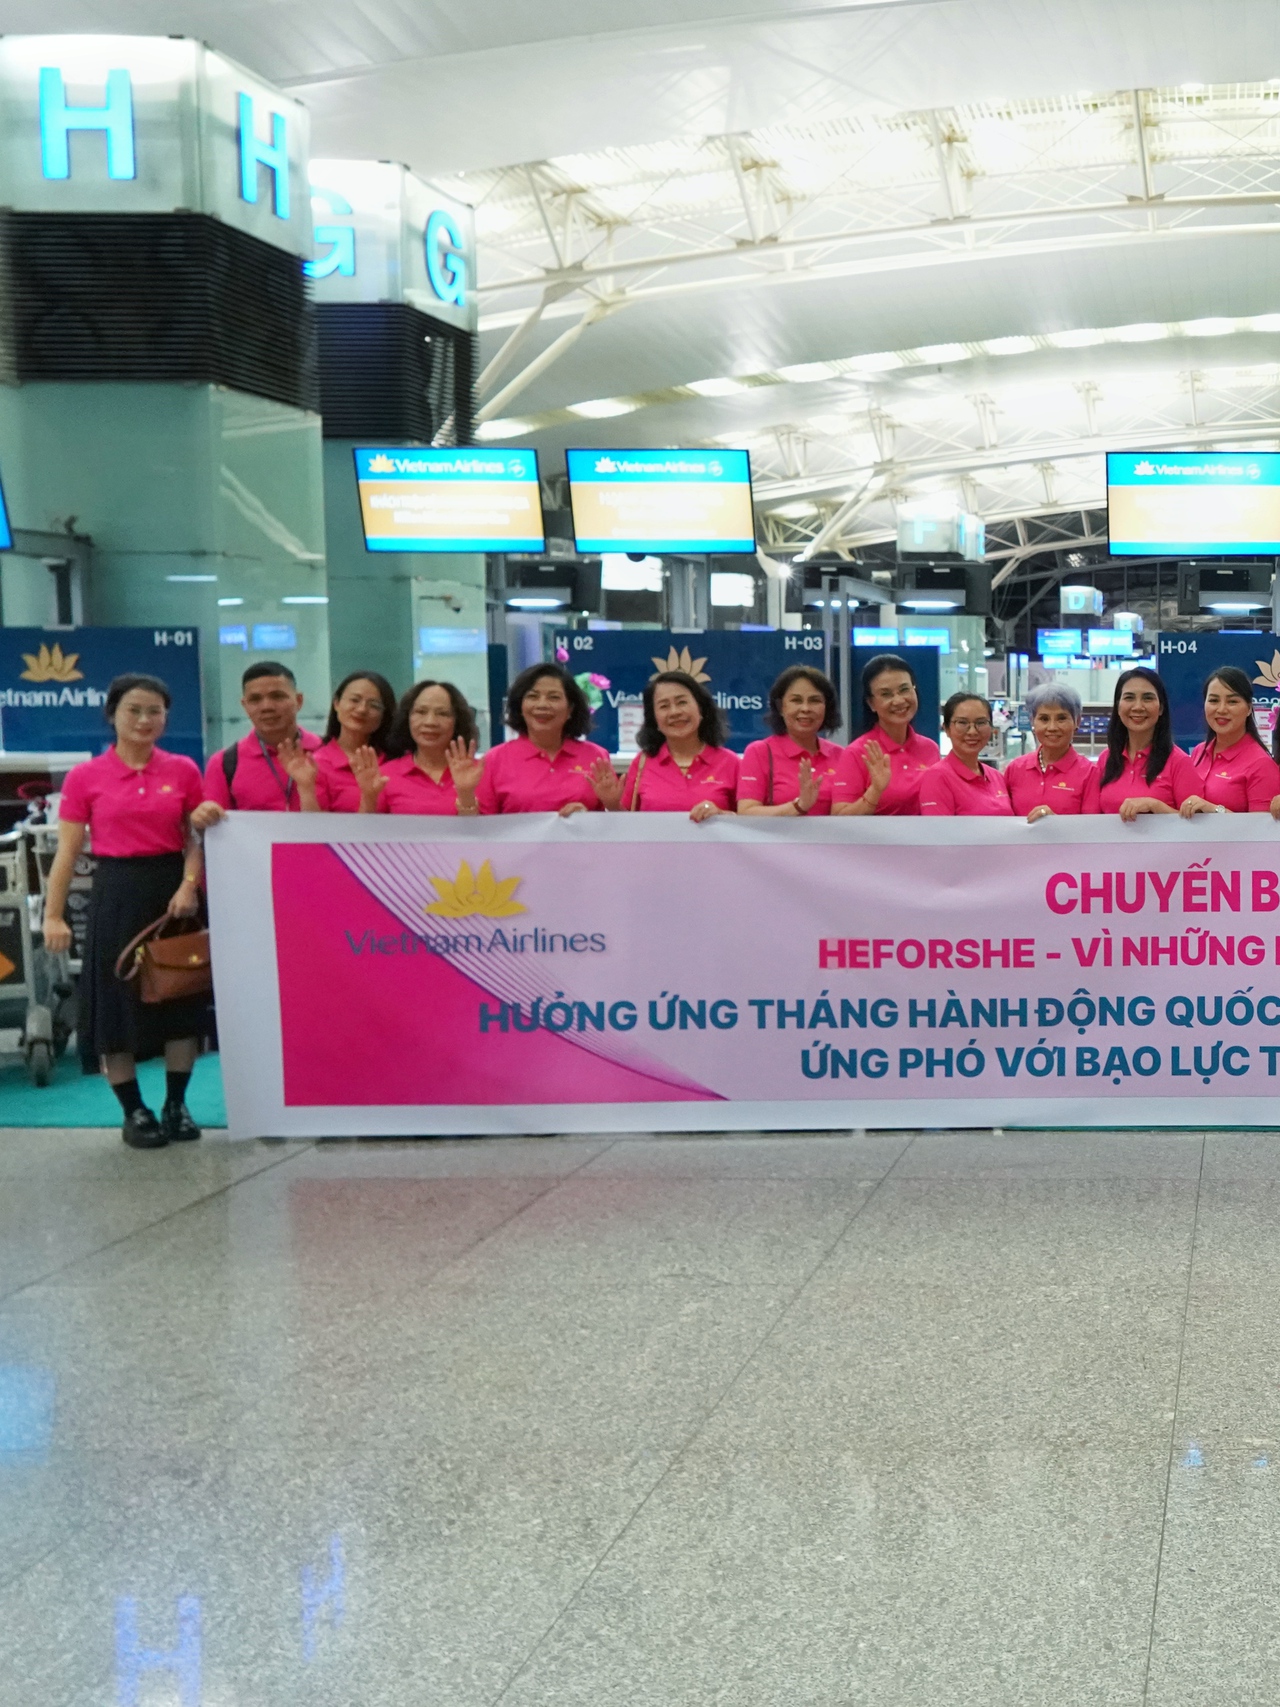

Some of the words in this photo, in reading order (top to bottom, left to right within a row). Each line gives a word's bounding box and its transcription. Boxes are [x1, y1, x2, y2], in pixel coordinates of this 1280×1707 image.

[39, 67, 136, 179] H
[239, 92, 290, 219] H
[425, 210, 465, 306] G
[1068, 592, 1086, 610] D
[154, 630, 193, 647] H-01
[784, 636, 824, 651] H-03
[1160, 640, 1198, 655] H-04
[0, 688, 58, 707] etnam
[59, 686, 107, 707] Airlin
[712, 691, 762, 710] lines
[1045, 858, 1241, 915] CHUYẾN
[343, 929, 481, 955] Vietnam
[487, 927, 607, 954] Airlines
[818, 938, 1036, 970] HEFORSHE
[1072, 928, 1113, 968] VÌ
[1123, 927, 1267, 968] NHỮNG
[478, 991, 638, 1034] HƯỞNG
[648, 991, 739, 1032] ỨNG
[748, 990, 899, 1031] THÁNG
[909, 989, 1029, 1030] HÀNH
[1034, 988, 1156, 1036] ĐỘNG
[801, 1040, 890, 1080] ỨNG
[899, 1039, 987, 1079] PHÓ
[995, 1038, 1067, 1078] VỚI
[1076, 1046, 1163, 1086] BẠO
[1171, 1040, 1251, 1085] LỰC
